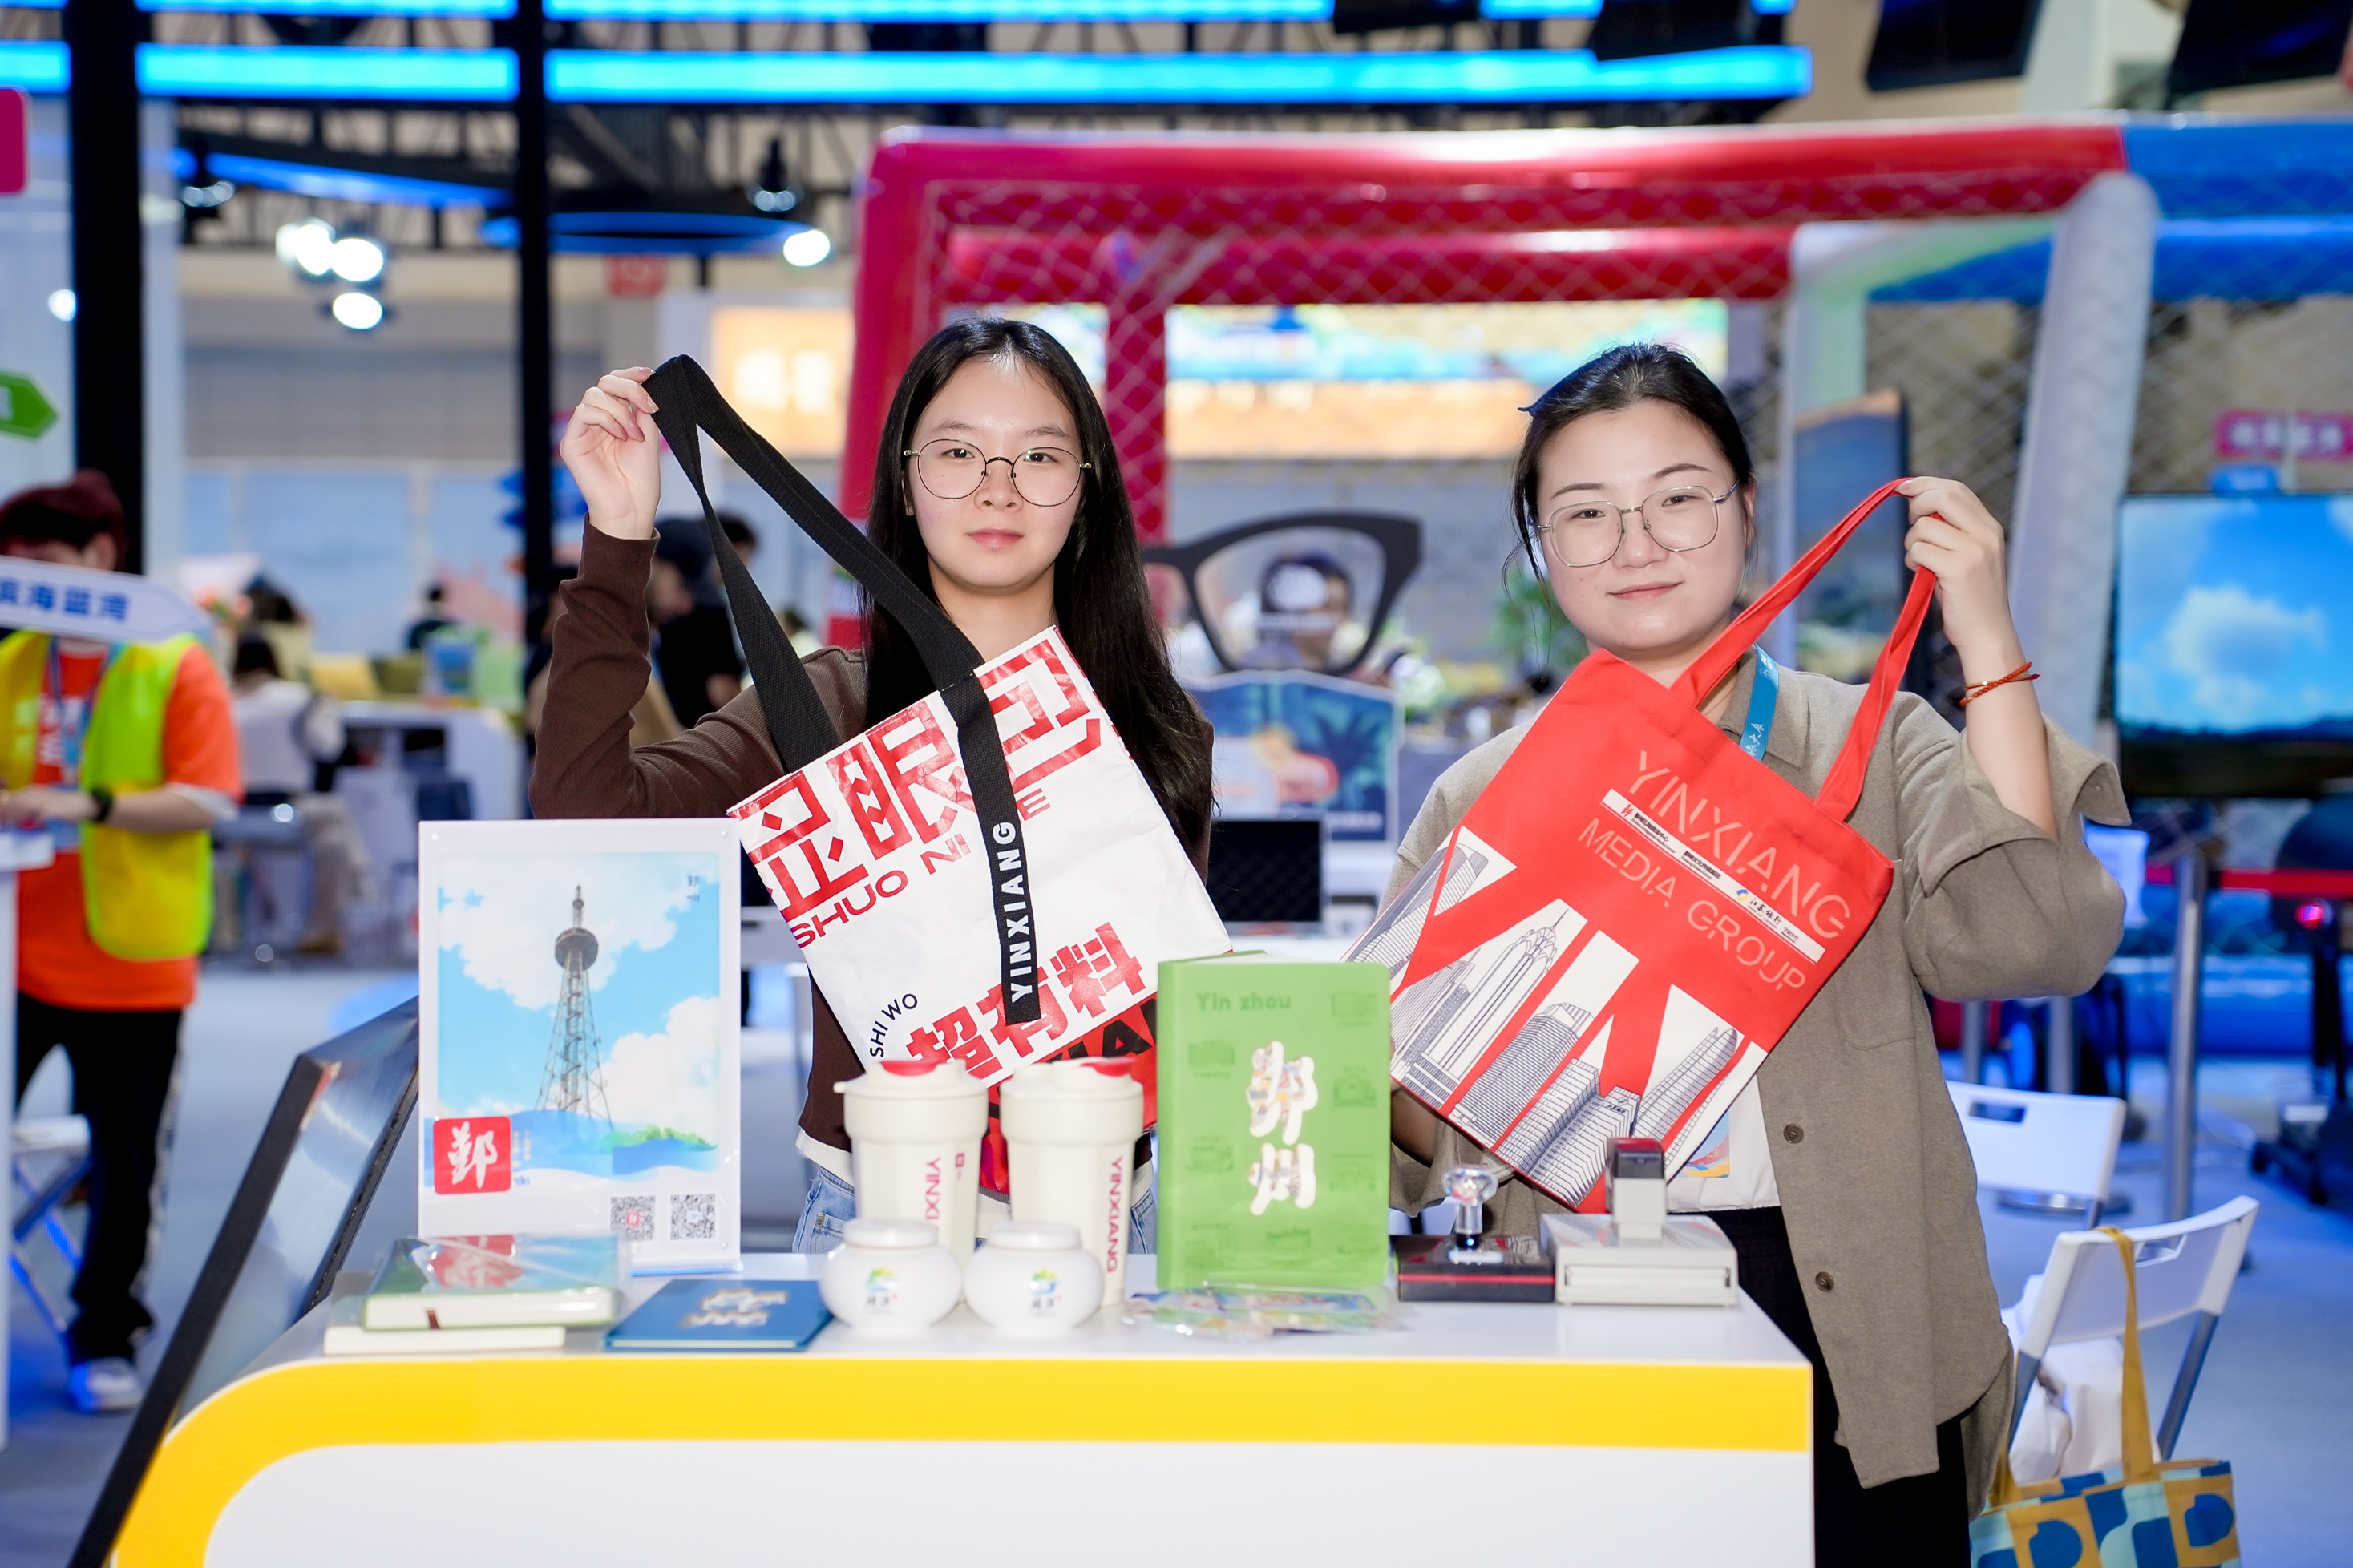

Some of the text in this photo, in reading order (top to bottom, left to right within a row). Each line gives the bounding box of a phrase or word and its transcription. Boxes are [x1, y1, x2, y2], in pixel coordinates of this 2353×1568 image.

[790, 870, 908, 949] SHUO
[920, 833, 971, 875] NI
[1628, 749, 1850, 938] YINXIANG
[992, 822, 1033, 1004] YINXIANG
[1577, 818, 1806, 991] MEDIA GROUP
[870, 993, 918, 1058] SHI WO
[906, 922, 1146, 1078] 超有料
[1196, 992, 1292, 1012] Yin zhou
[925, 1157, 941, 1220] YINXI
[1106, 1155, 1124, 1273] YINXIANG
